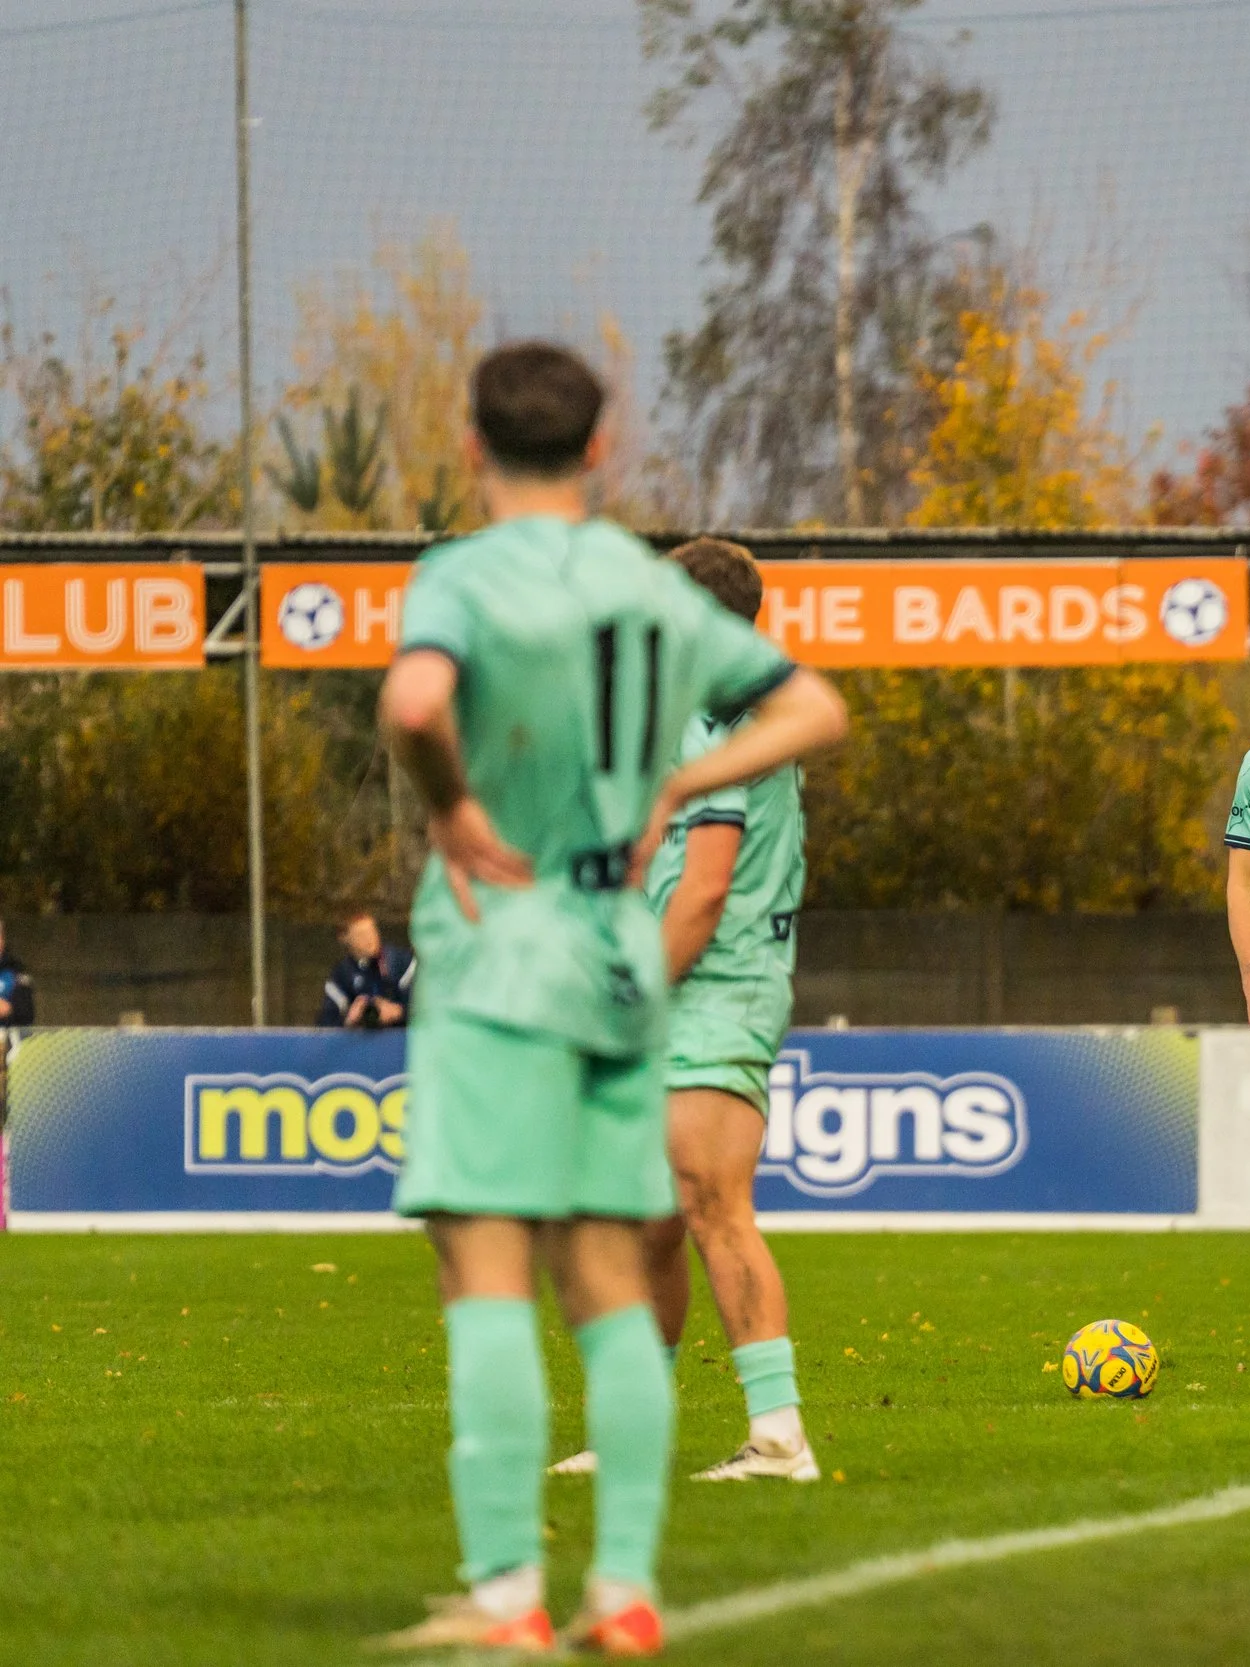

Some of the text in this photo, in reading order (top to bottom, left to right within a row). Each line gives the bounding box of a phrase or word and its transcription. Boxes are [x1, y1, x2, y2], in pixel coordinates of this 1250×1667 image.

[3, 578, 198, 653] LUB
[763, 586, 865, 643] HE
[892, 586, 1148, 643] BARDS
[595, 622, 663, 775] 11
[765, 1063, 1017, 1182] igns
